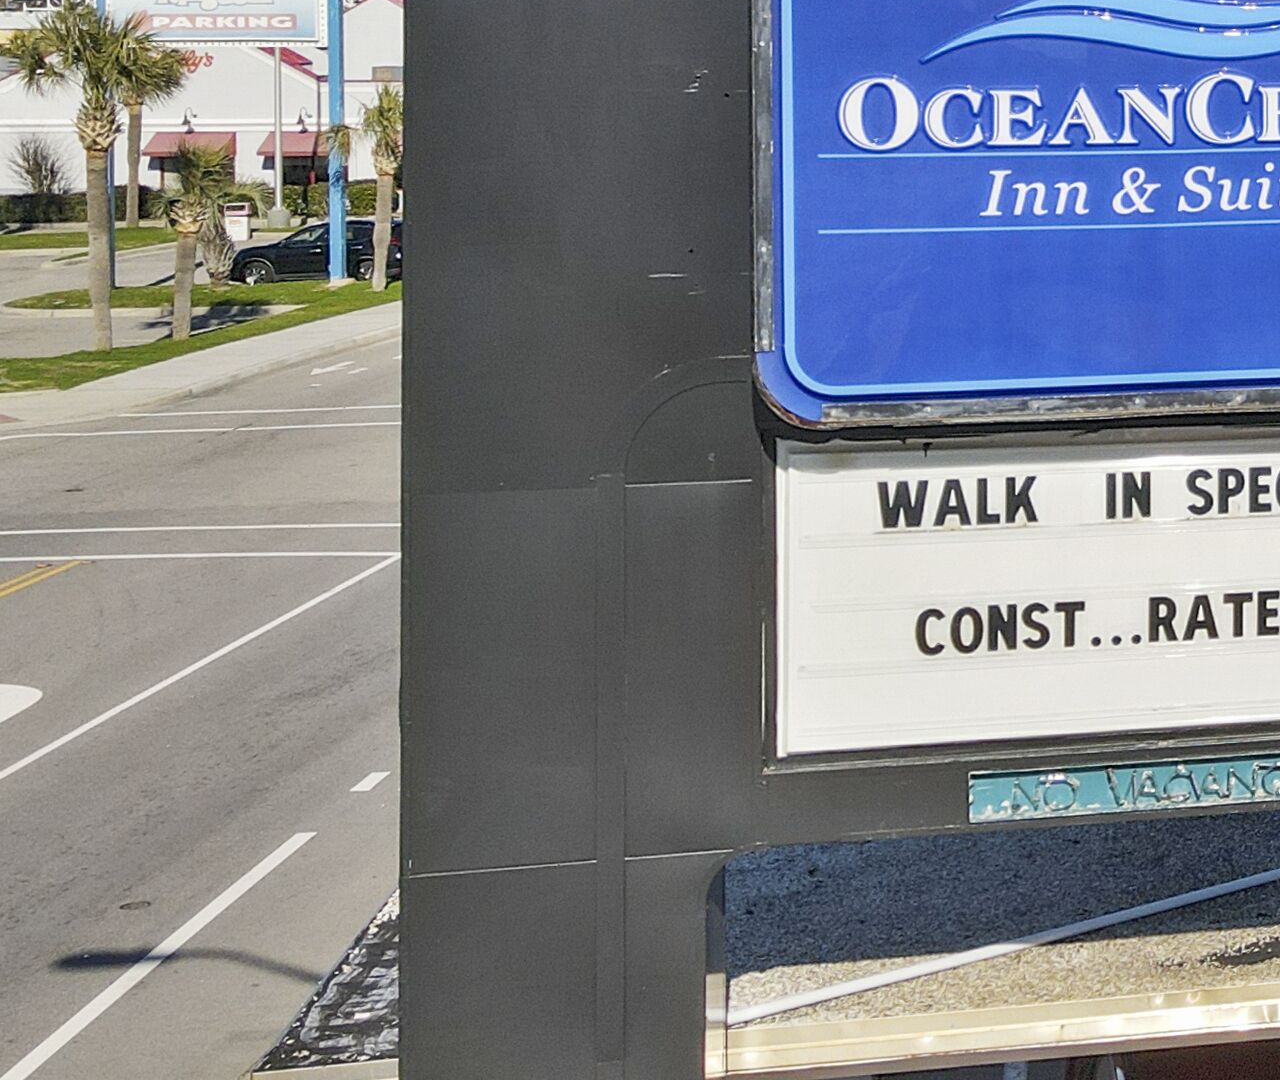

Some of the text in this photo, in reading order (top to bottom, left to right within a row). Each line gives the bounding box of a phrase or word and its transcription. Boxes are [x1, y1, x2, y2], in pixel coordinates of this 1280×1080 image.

[152, 16, 293, 28] PARKING
[980, 169, 1089, 217] Inn
[1112, 167, 1161, 215] &
[877, 475, 1039, 529] WALK
[1105, 471, 1153, 520] IN
[1012, 773, 1078, 812] NO
